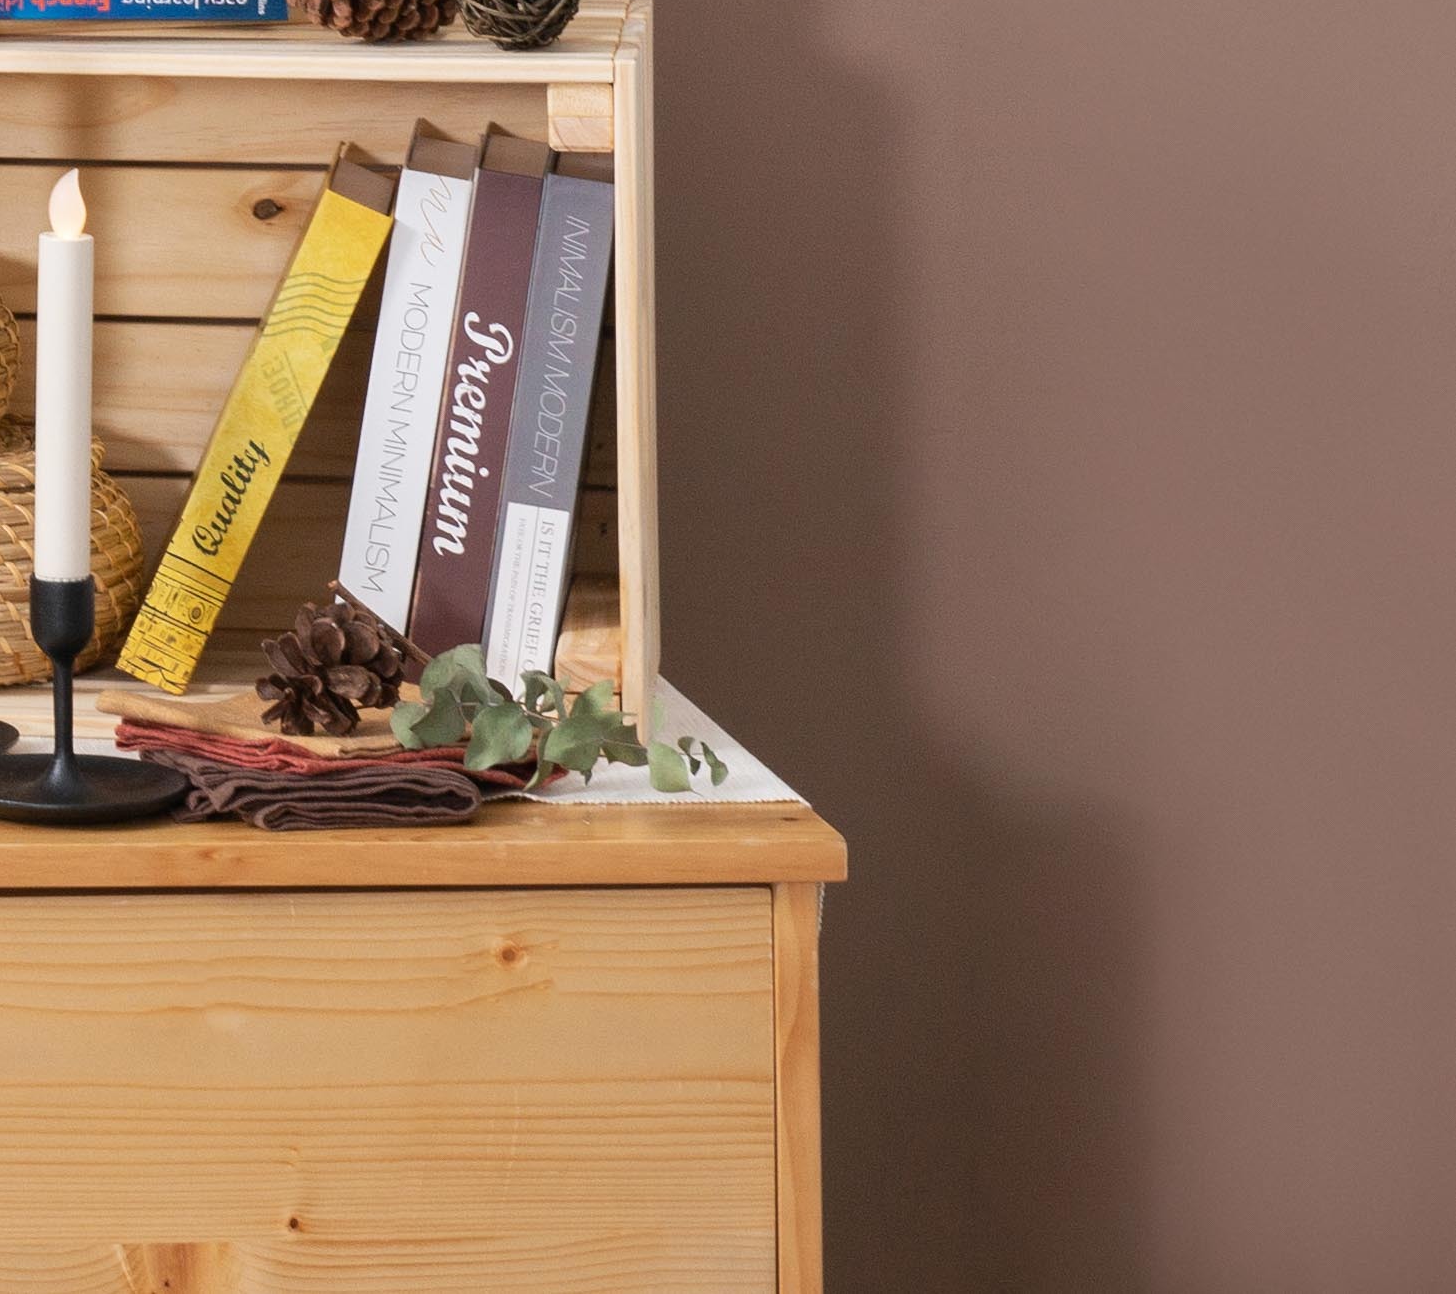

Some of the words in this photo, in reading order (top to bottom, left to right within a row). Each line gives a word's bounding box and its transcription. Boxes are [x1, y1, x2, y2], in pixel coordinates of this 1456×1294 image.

[390, 282, 432, 413] MODERN
[547, 215, 591, 364] INIMALISM
[433, 311, 514, 557] Premium
[529, 364, 570, 498] MODERN
[192, 439, 271, 556] Quality
[361, 419, 411, 593] MINIMALISM
[537, 541, 552, 557] IT
[542, 521, 555, 537] IS
[531, 561, 550, 598] THE
